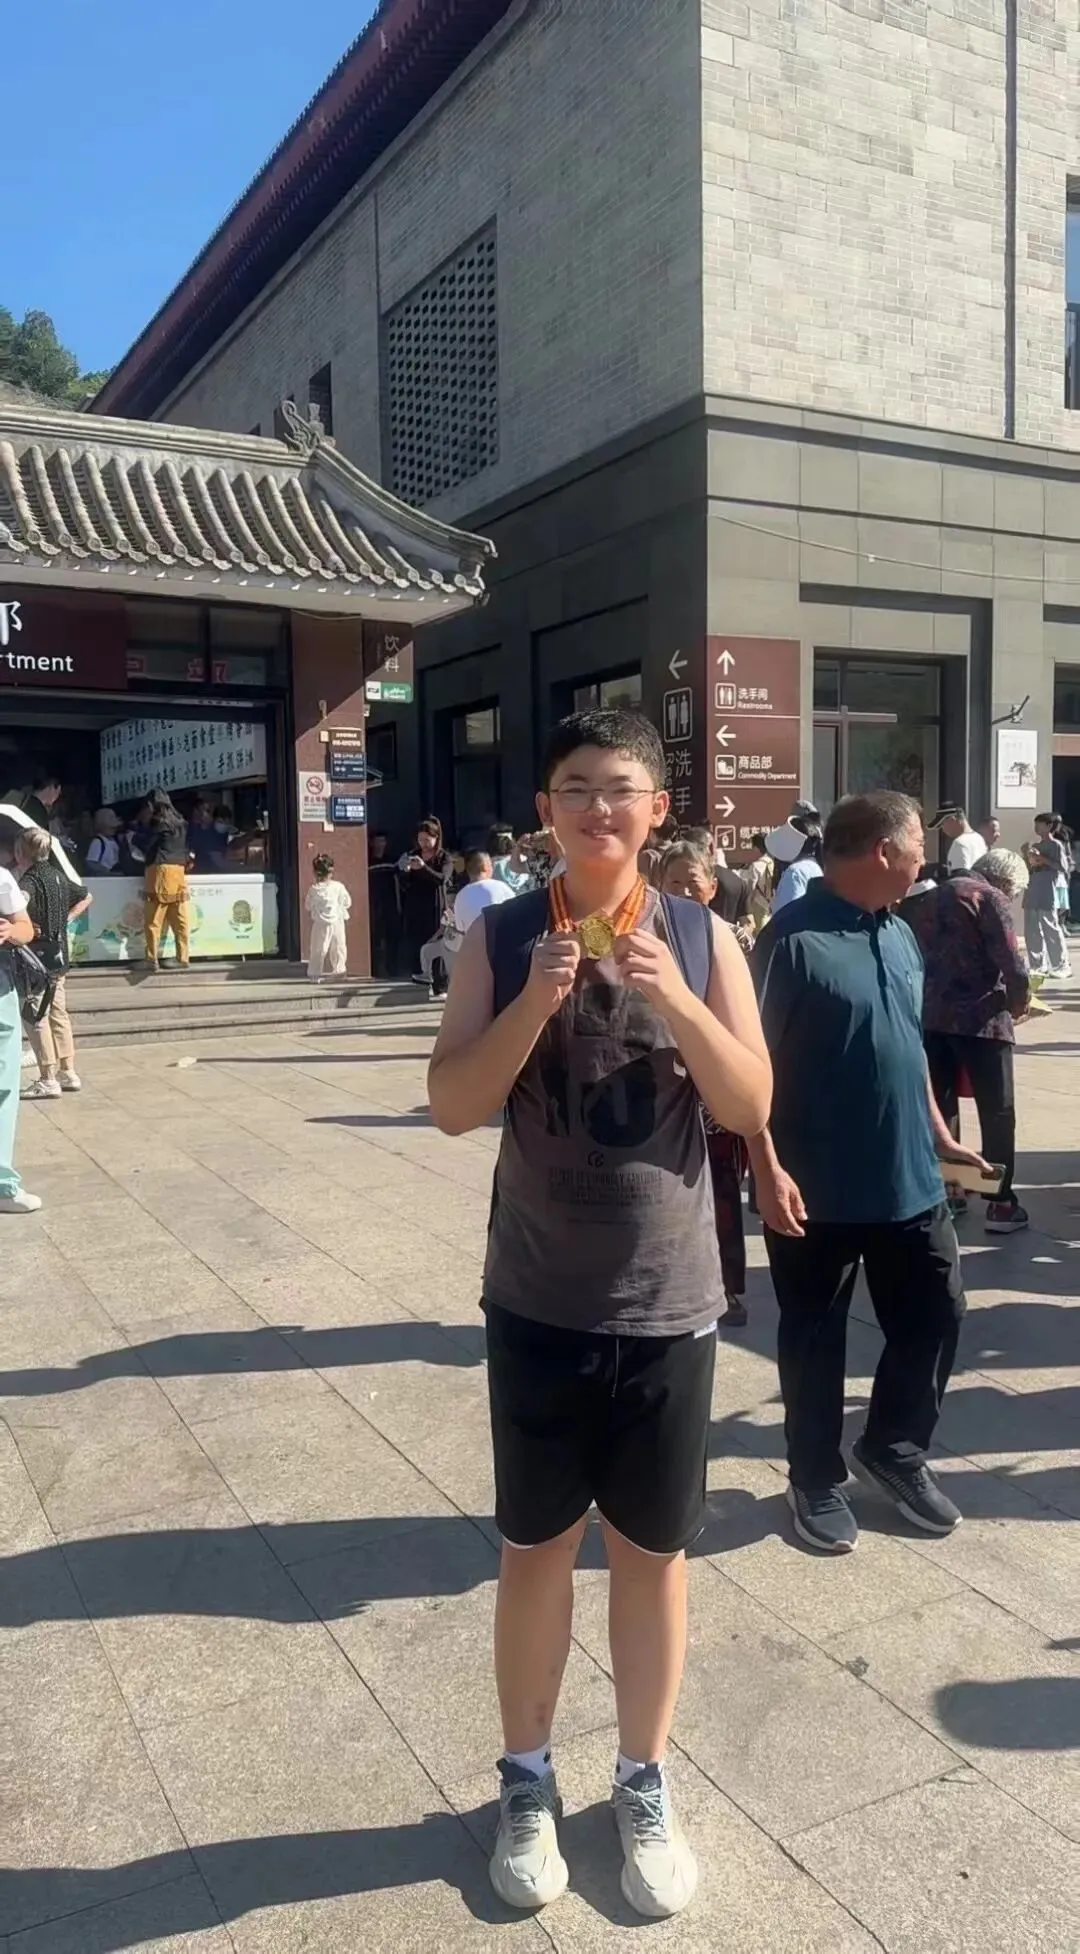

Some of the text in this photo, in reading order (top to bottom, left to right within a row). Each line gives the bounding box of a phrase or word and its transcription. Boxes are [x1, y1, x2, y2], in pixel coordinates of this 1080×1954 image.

[0, 652, 74, 672] tment
[384, 635, 400, 673] 饮料
[738, 755, 773, 769] 商品部
